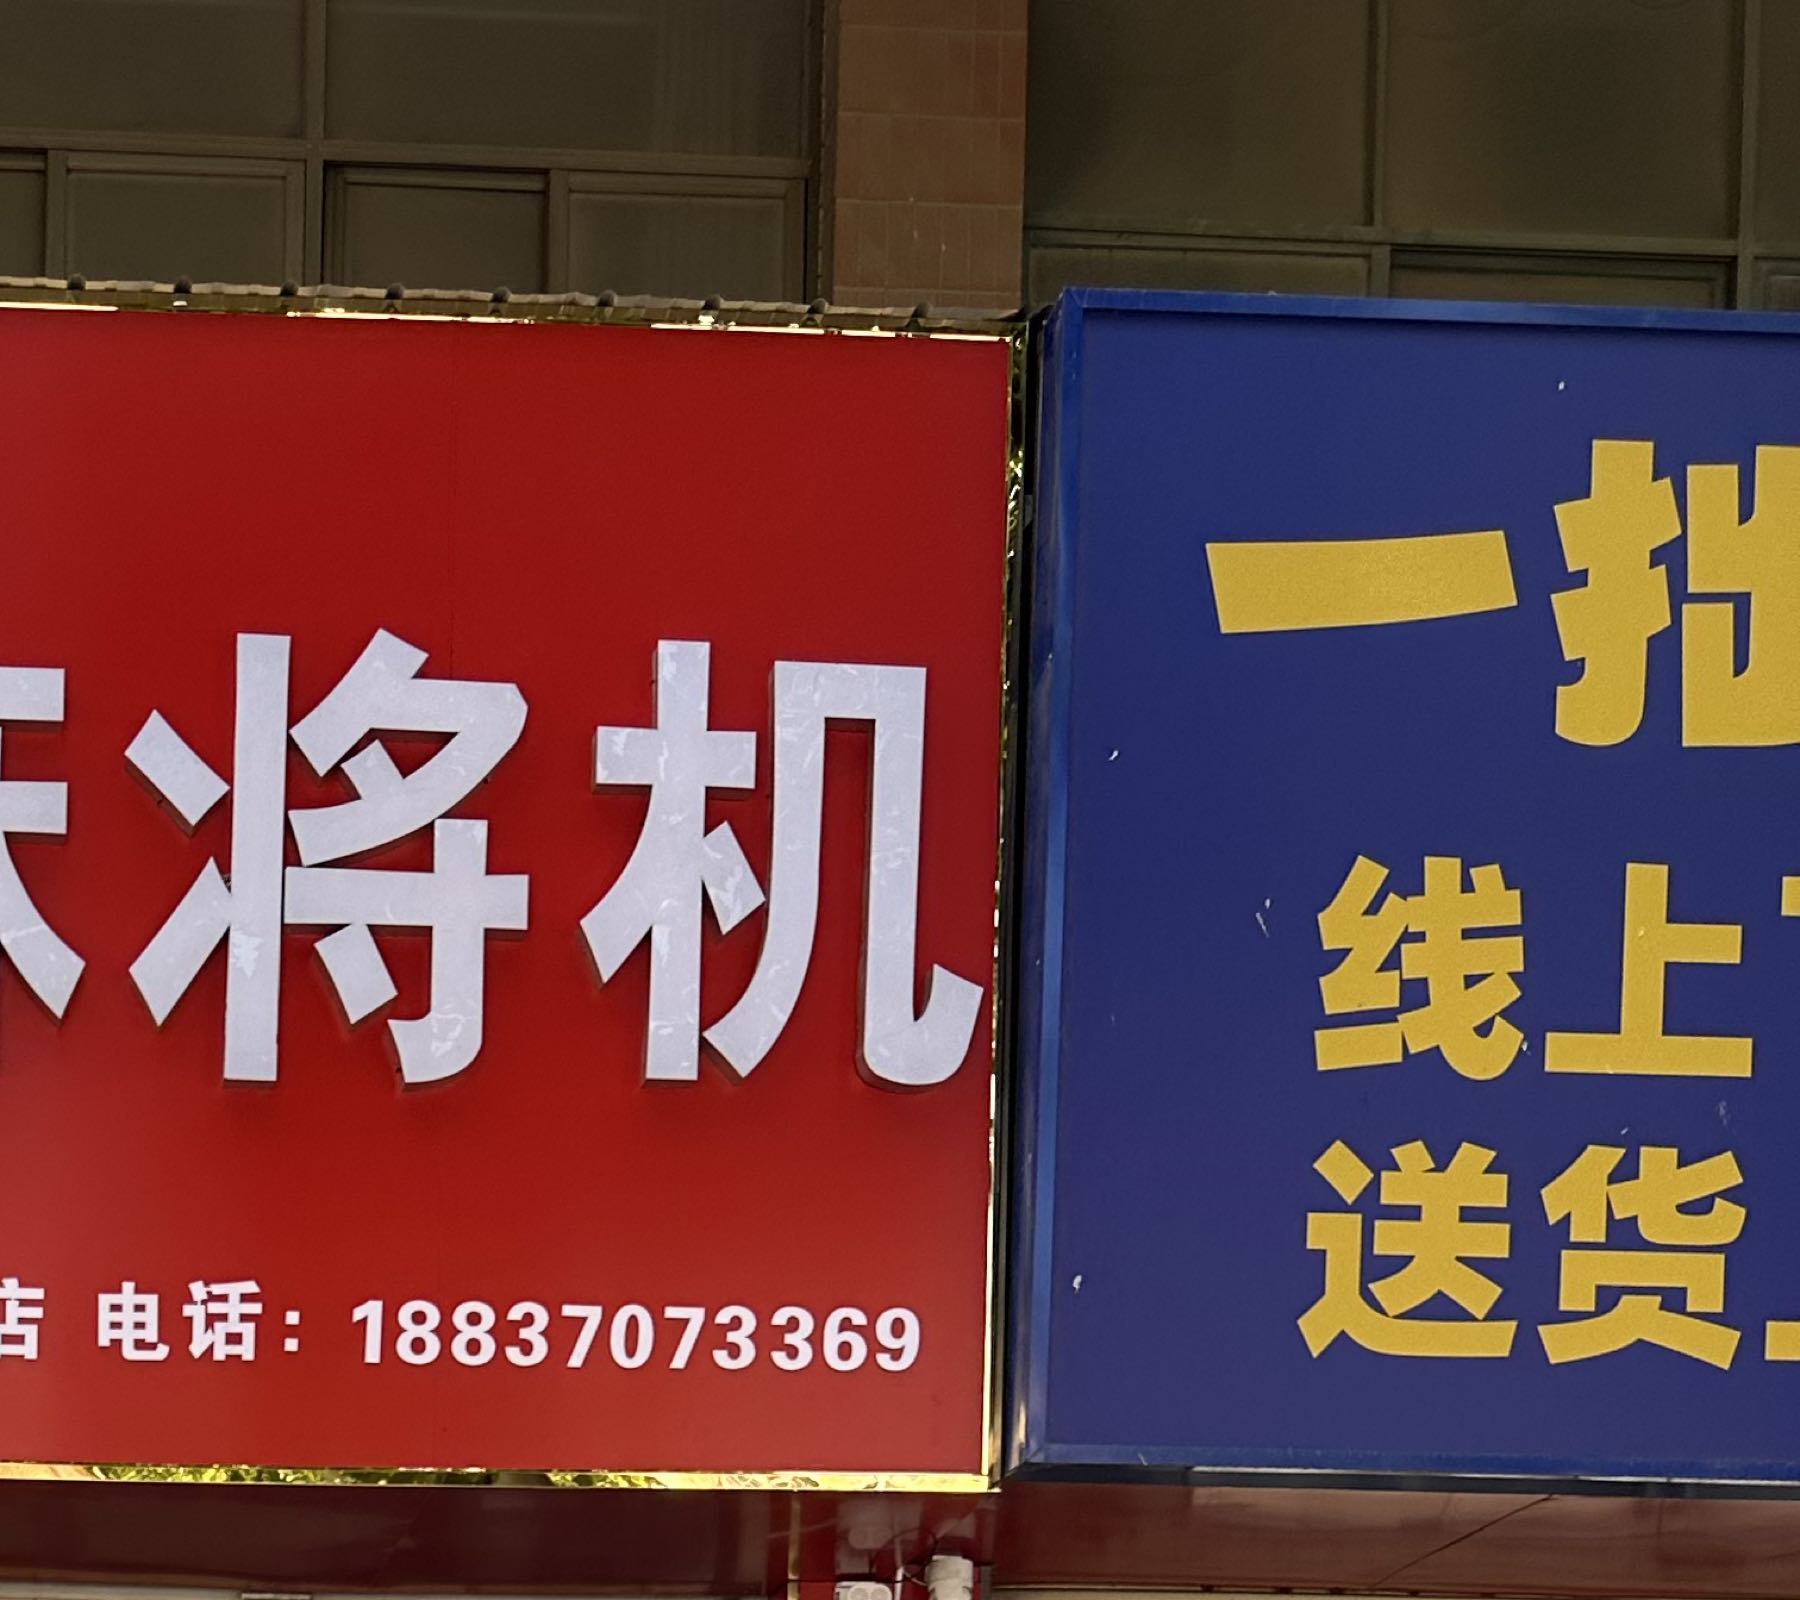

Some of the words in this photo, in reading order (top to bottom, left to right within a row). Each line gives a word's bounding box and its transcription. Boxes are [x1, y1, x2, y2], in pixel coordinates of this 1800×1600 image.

[1314, 854, 1800, 1081] 线上
[350, 1298, 922, 1373] 18837073369
[1297, 1138, 1800, 1370] 送货
